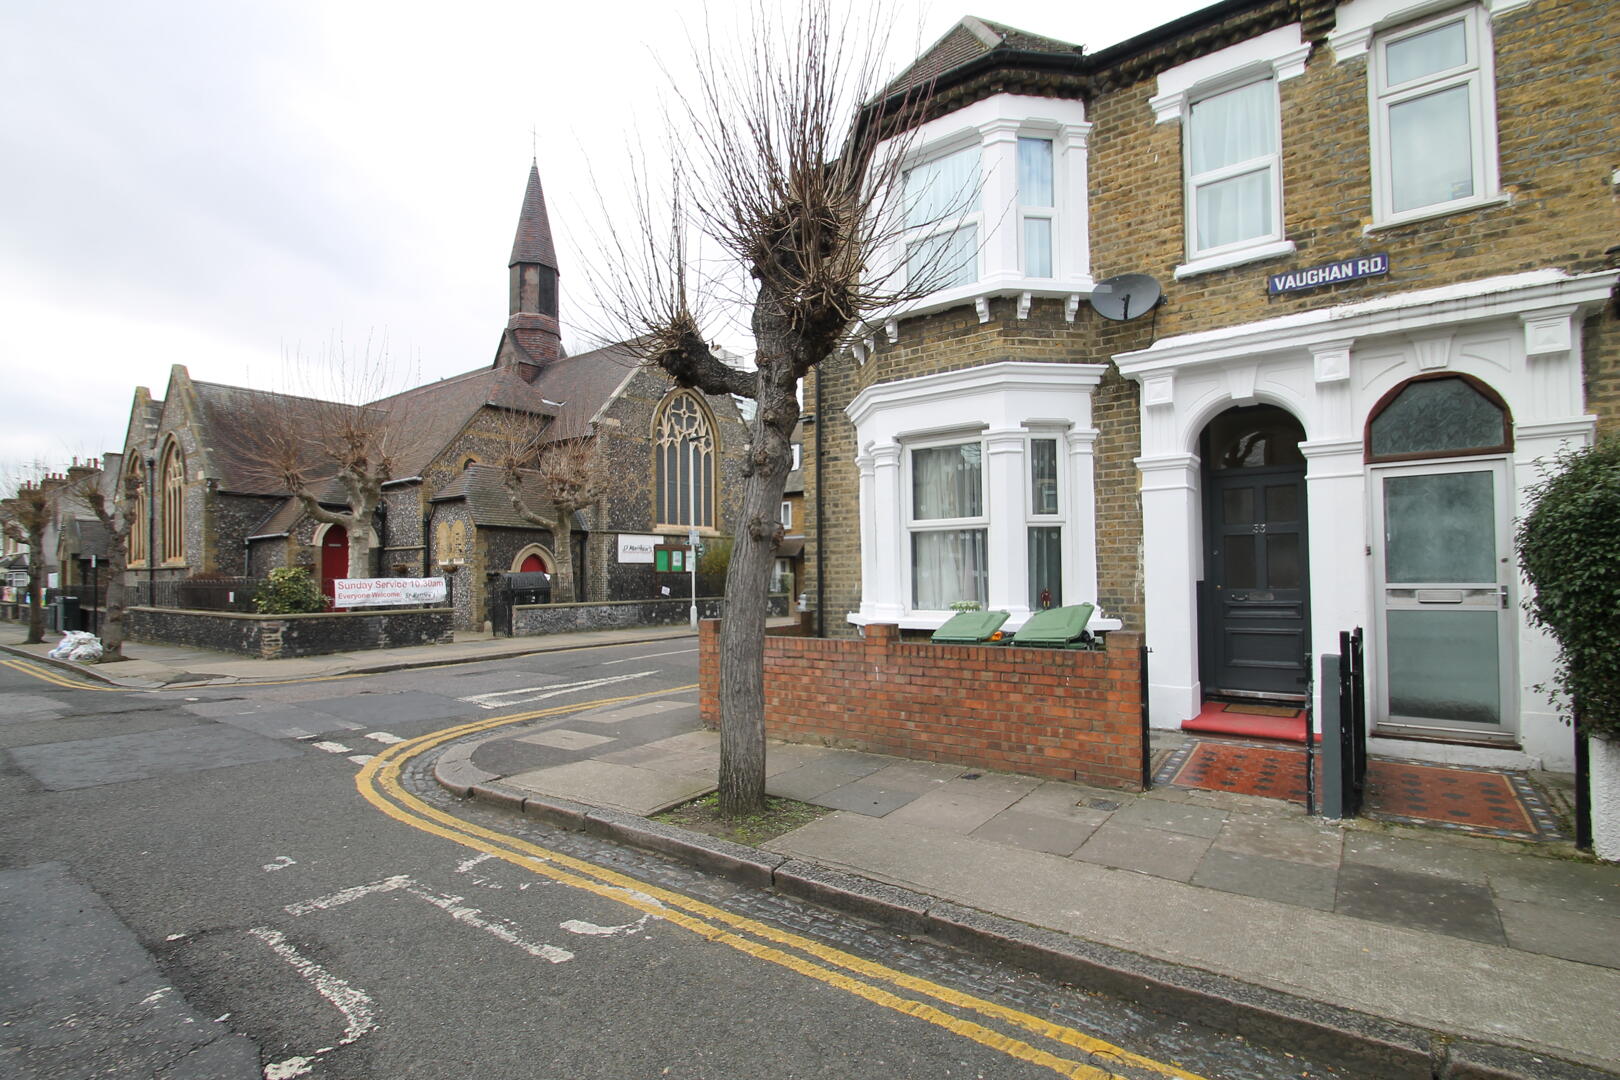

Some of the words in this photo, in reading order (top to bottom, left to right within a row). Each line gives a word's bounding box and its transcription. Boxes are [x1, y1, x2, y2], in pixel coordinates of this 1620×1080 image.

[1275, 263, 1353, 290] VAUGHAN
[1358, 257, 1386, 275] RD.
[338, 581, 372, 590] Sunday
[376, 580, 407, 588] Service
